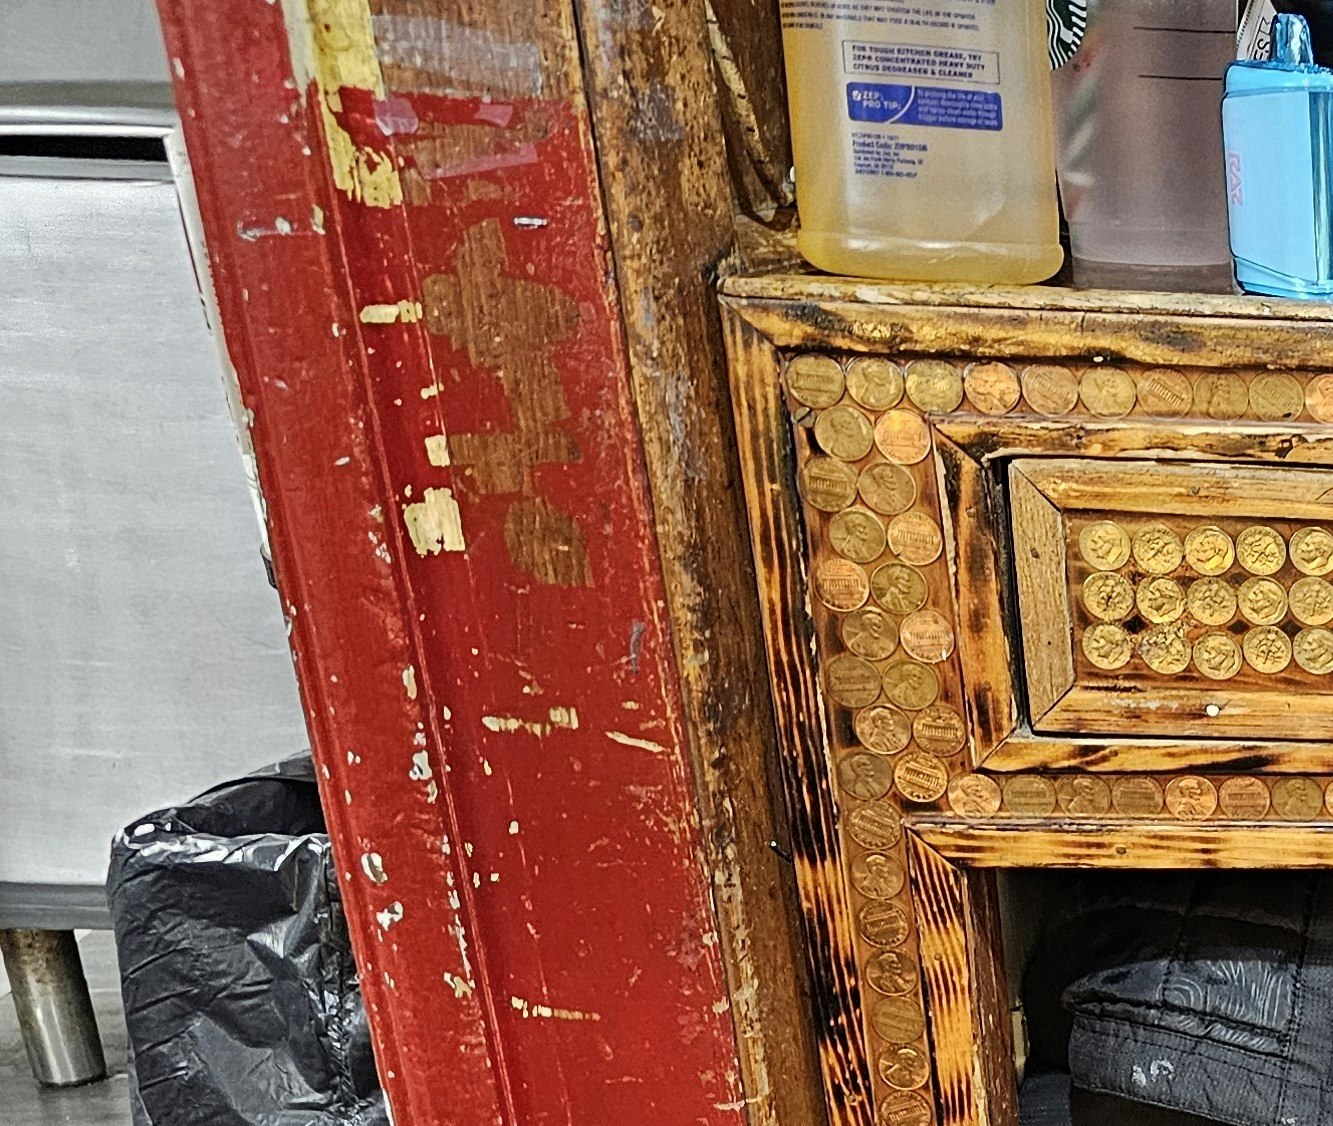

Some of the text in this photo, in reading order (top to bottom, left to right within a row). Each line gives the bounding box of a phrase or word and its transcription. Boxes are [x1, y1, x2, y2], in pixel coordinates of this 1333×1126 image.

[869, 46, 896, 54] TOUGH
[896, 47, 932, 57] KITCHEN
[968, 53, 983, 62] TRY
[853, 63, 881, 72] CITRUS
[881, 65, 929, 75] DEGREASER
[938, 69, 974, 79] CLEANER
[875, 56, 937, 67] CONCENTRATED
[938, 60, 964, 69] HEAVY
[966, 63, 986, 72] DUTY
[862, 100, 881, 109] PRO
